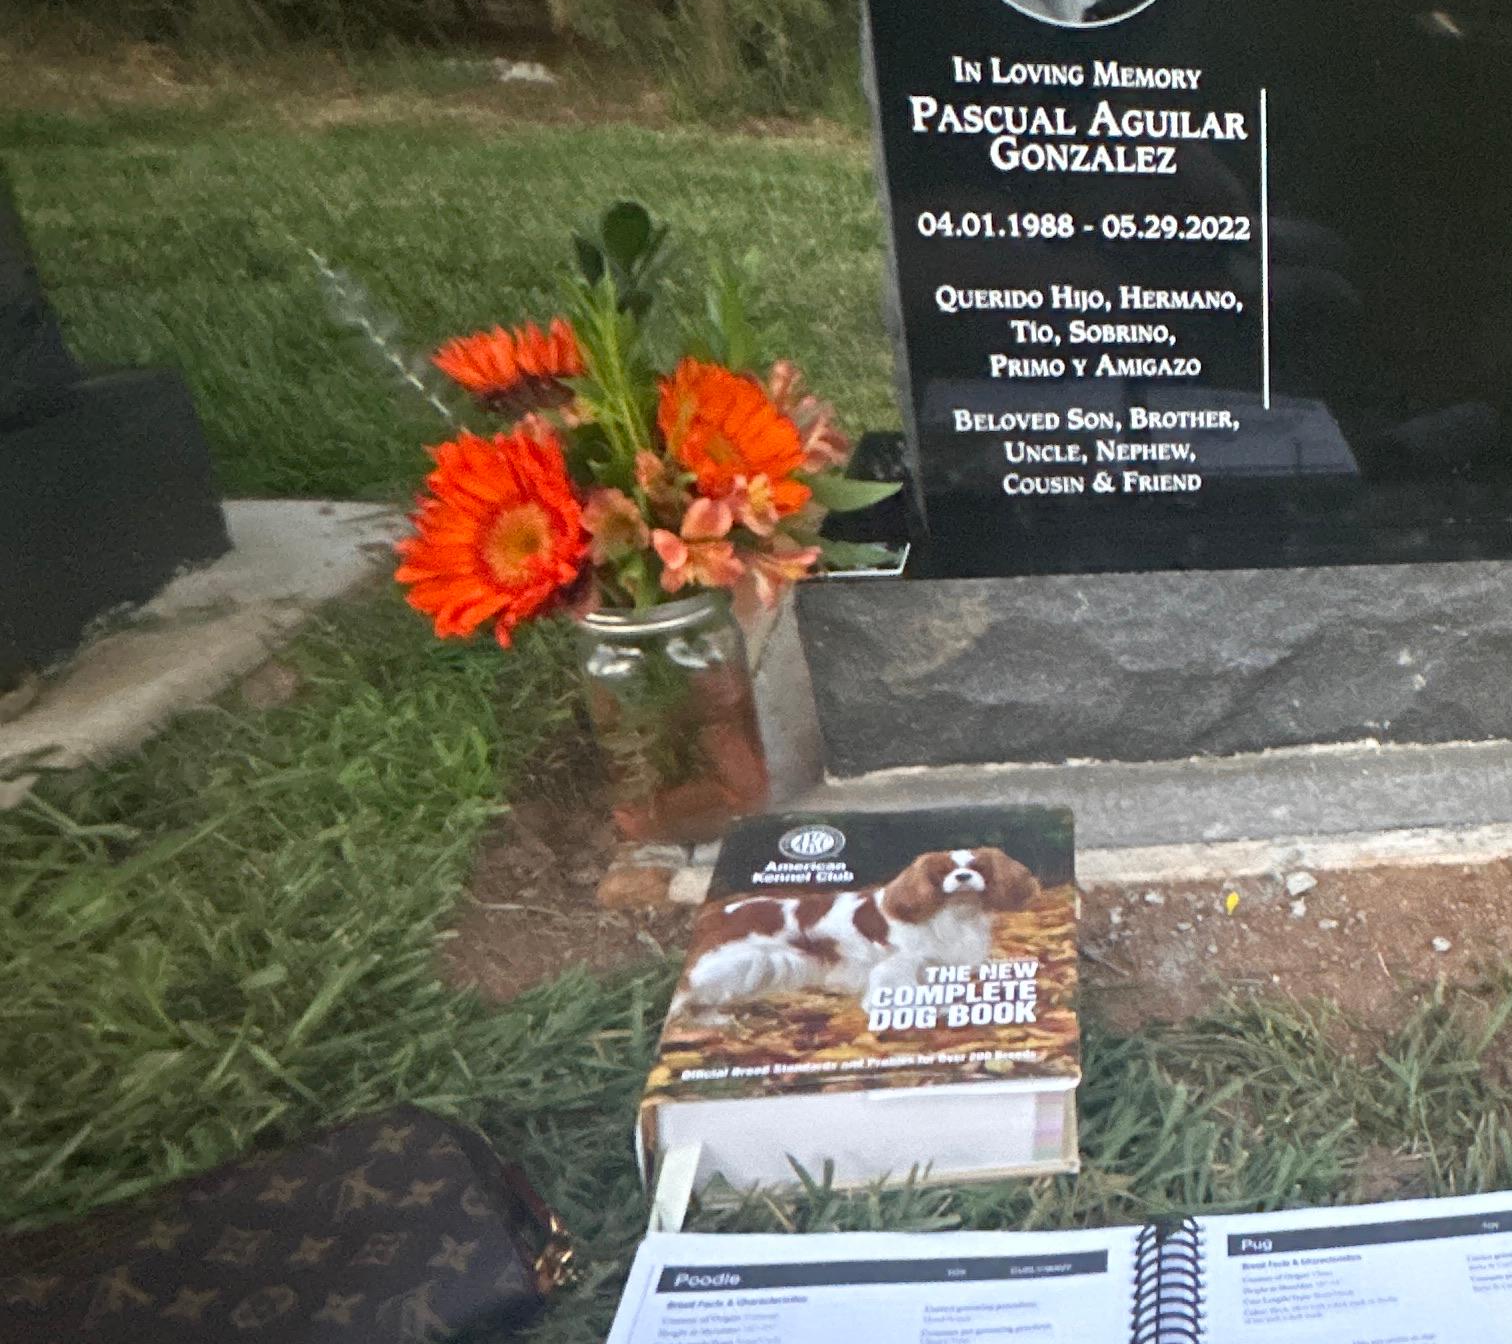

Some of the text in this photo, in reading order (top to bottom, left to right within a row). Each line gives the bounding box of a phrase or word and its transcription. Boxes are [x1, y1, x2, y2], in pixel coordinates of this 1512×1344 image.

[909, 95, 1249, 140] PASCUAL AGUILAR
[989, 135, 1177, 174] GONZALEZ
[917, 211, 1075, 239] 04.01.1988
[1101, 213, 1251, 241] 05.29.2022
[1092, 471, 1116, 493] &
[926, 961, 1039, 983] THE NEW
[871, 980, 1038, 1007] COMPLETE
[868, 1001, 1037, 1032] DOG BOOK
[1241, 1238, 1273, 1253] Pug
[674, 1271, 742, 1289] Poodle
